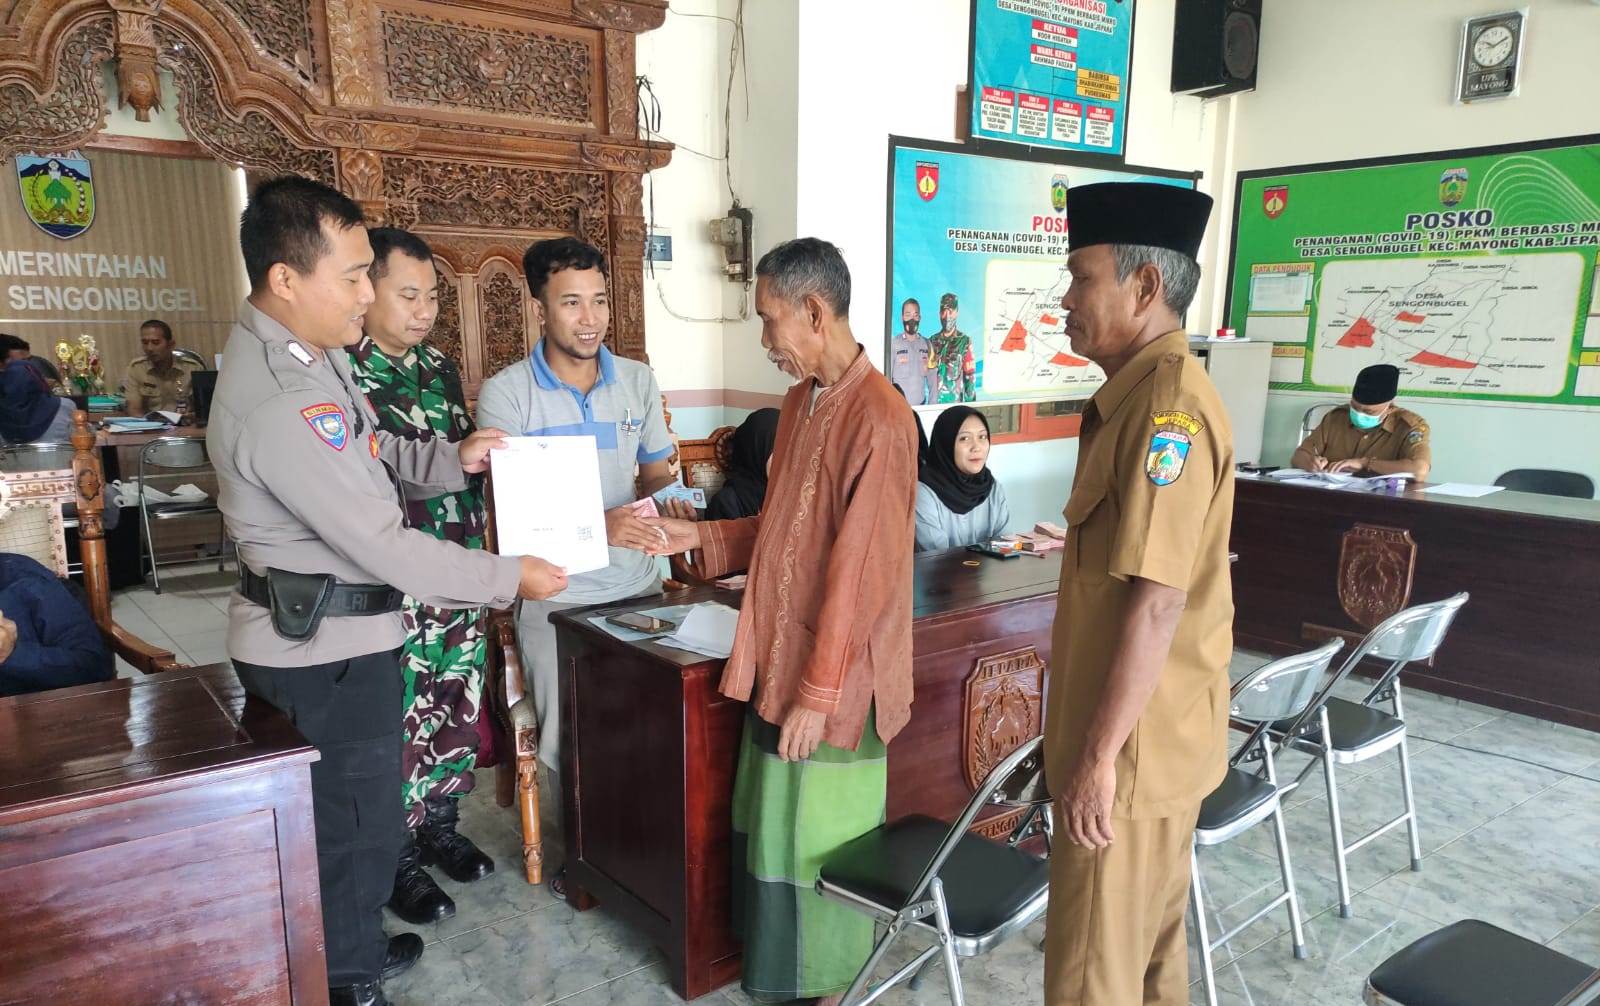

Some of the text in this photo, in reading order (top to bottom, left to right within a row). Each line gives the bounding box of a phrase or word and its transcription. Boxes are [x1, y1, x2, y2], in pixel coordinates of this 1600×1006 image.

[1043, 22, 1067, 35] KETUA
[1055, 50, 1072, 60] KETUA
[1407, 210, 1492, 230] POSKO
[948, 229, 1009, 241] PENANGANAN
[1013, 233, 1059, 245] (COVID-19)
[1295, 234, 1372, 246] PENANGANAN
[1377, 231, 1449, 244] (COVID-19)
[1455, 228, 1495, 238] PPKM
[1501, 223, 1575, 236] BERBASIS
[955, 242, 978, 251] DESA
[981, 243, 1044, 254] SENGONBUGEL
[1302, 247, 1330, 256] DESA
[1335, 244, 1424, 255] SENGONBUGEL
[1253, 265, 1270, 273] DATA
[8, 285, 206, 312] SENGONBUGEL
[983, 655, 1036, 679] JEPARA
